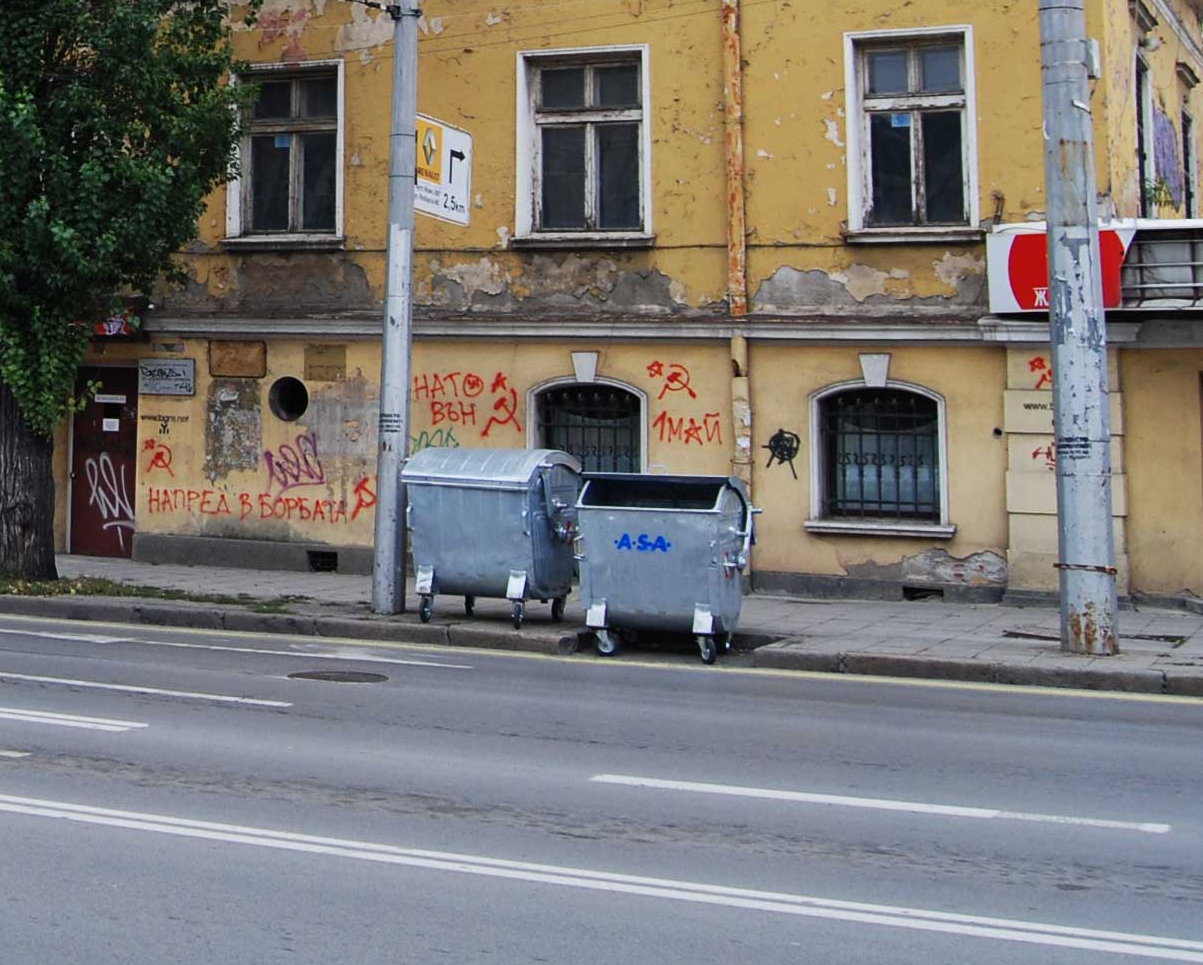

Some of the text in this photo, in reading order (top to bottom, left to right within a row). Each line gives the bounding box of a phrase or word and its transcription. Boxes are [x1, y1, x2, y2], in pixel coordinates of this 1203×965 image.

[149, 488, 348, 524] НАПРЕД В БОРБАТА
